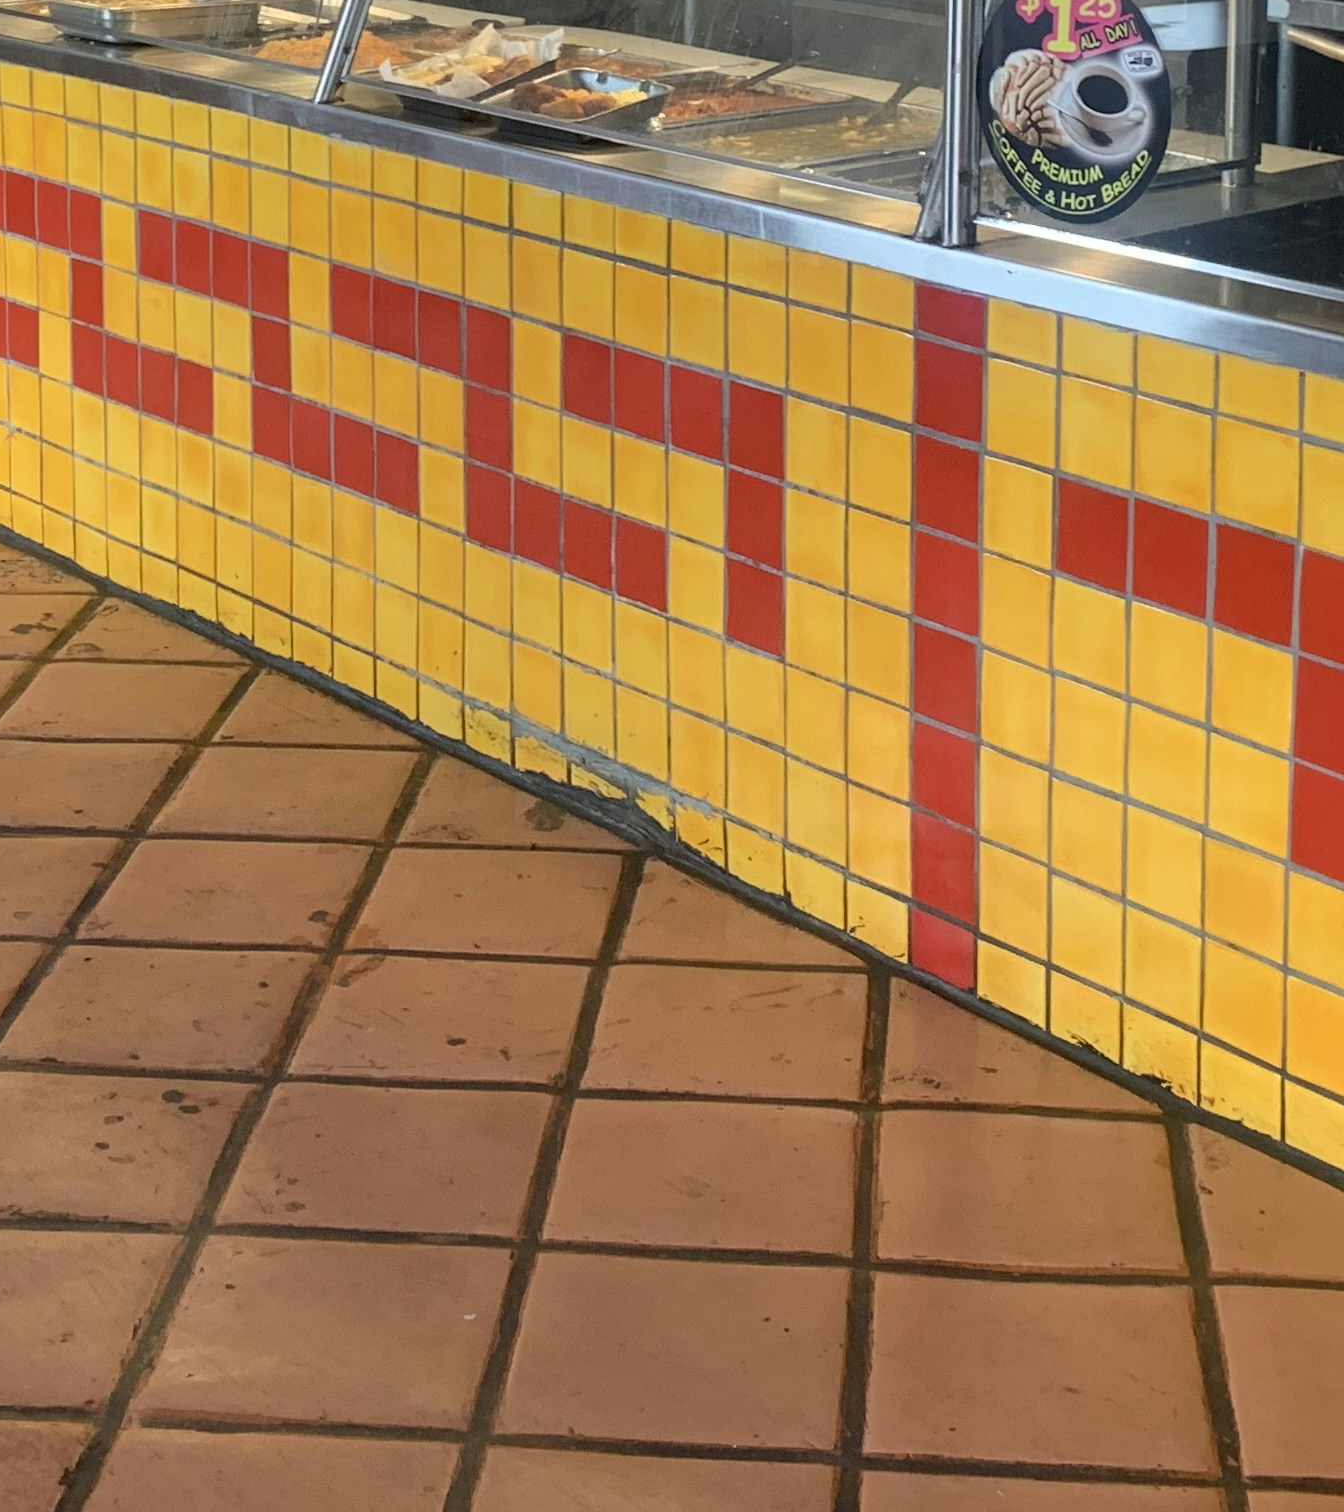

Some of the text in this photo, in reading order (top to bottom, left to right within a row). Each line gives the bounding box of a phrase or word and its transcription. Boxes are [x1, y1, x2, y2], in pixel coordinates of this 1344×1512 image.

[1080, 30, 1101, 51] ALL
[991, 119, 1150, 211] COFFEE & HOT BREAD
[1031, 148, 1104, 186] PREMIUM
